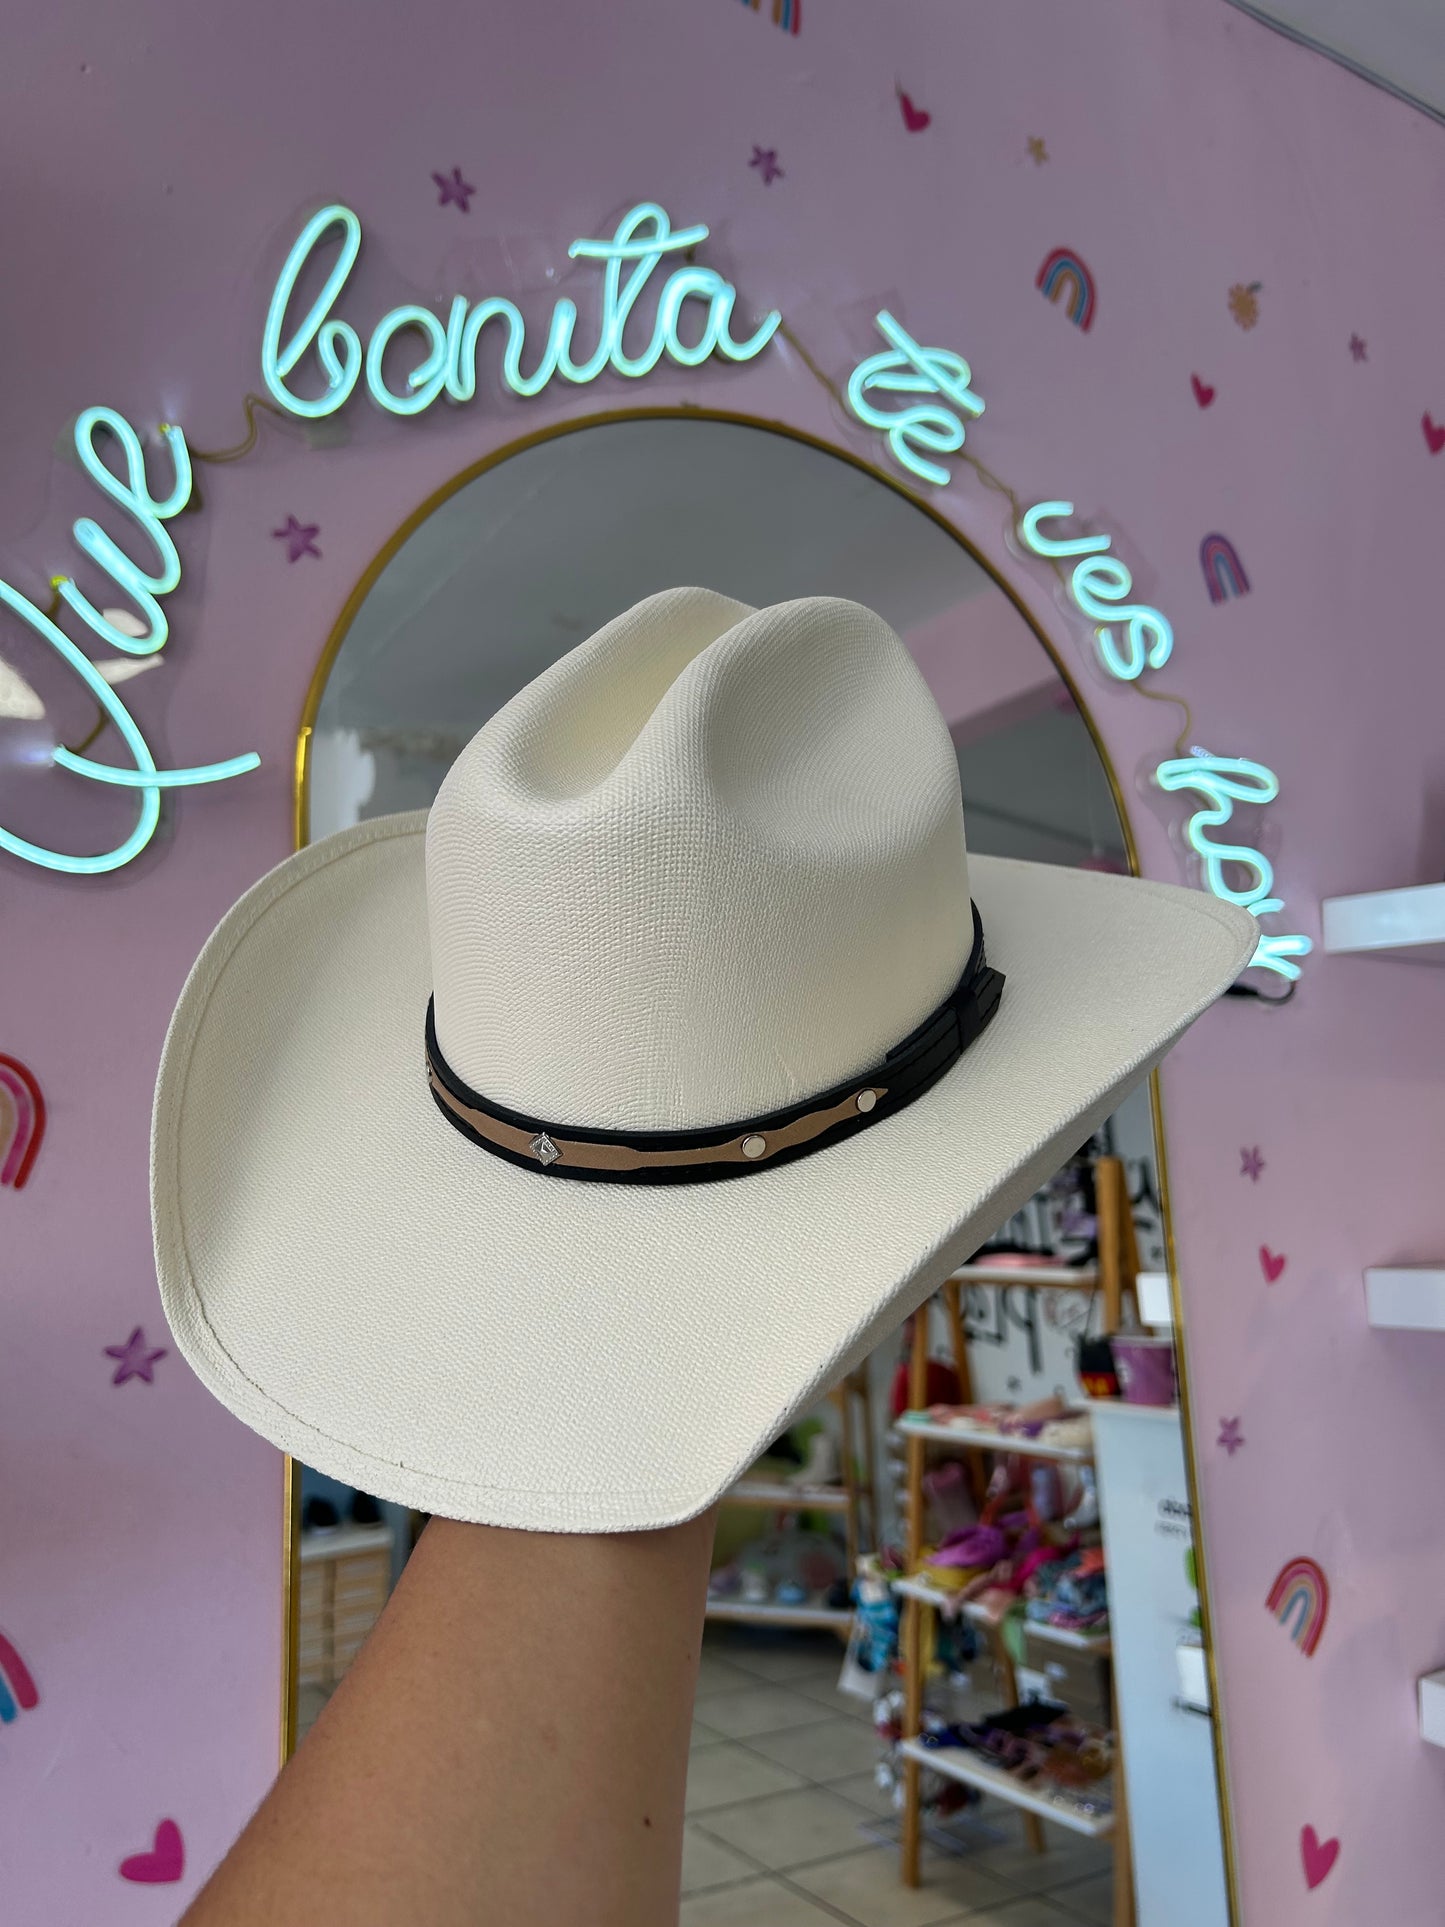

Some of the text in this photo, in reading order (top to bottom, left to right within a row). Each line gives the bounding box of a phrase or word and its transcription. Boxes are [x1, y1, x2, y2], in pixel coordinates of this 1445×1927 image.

[263, 203, 782, 417] bonita
[848, 309, 985, 485] te
[1022, 501, 1173, 680] ves
